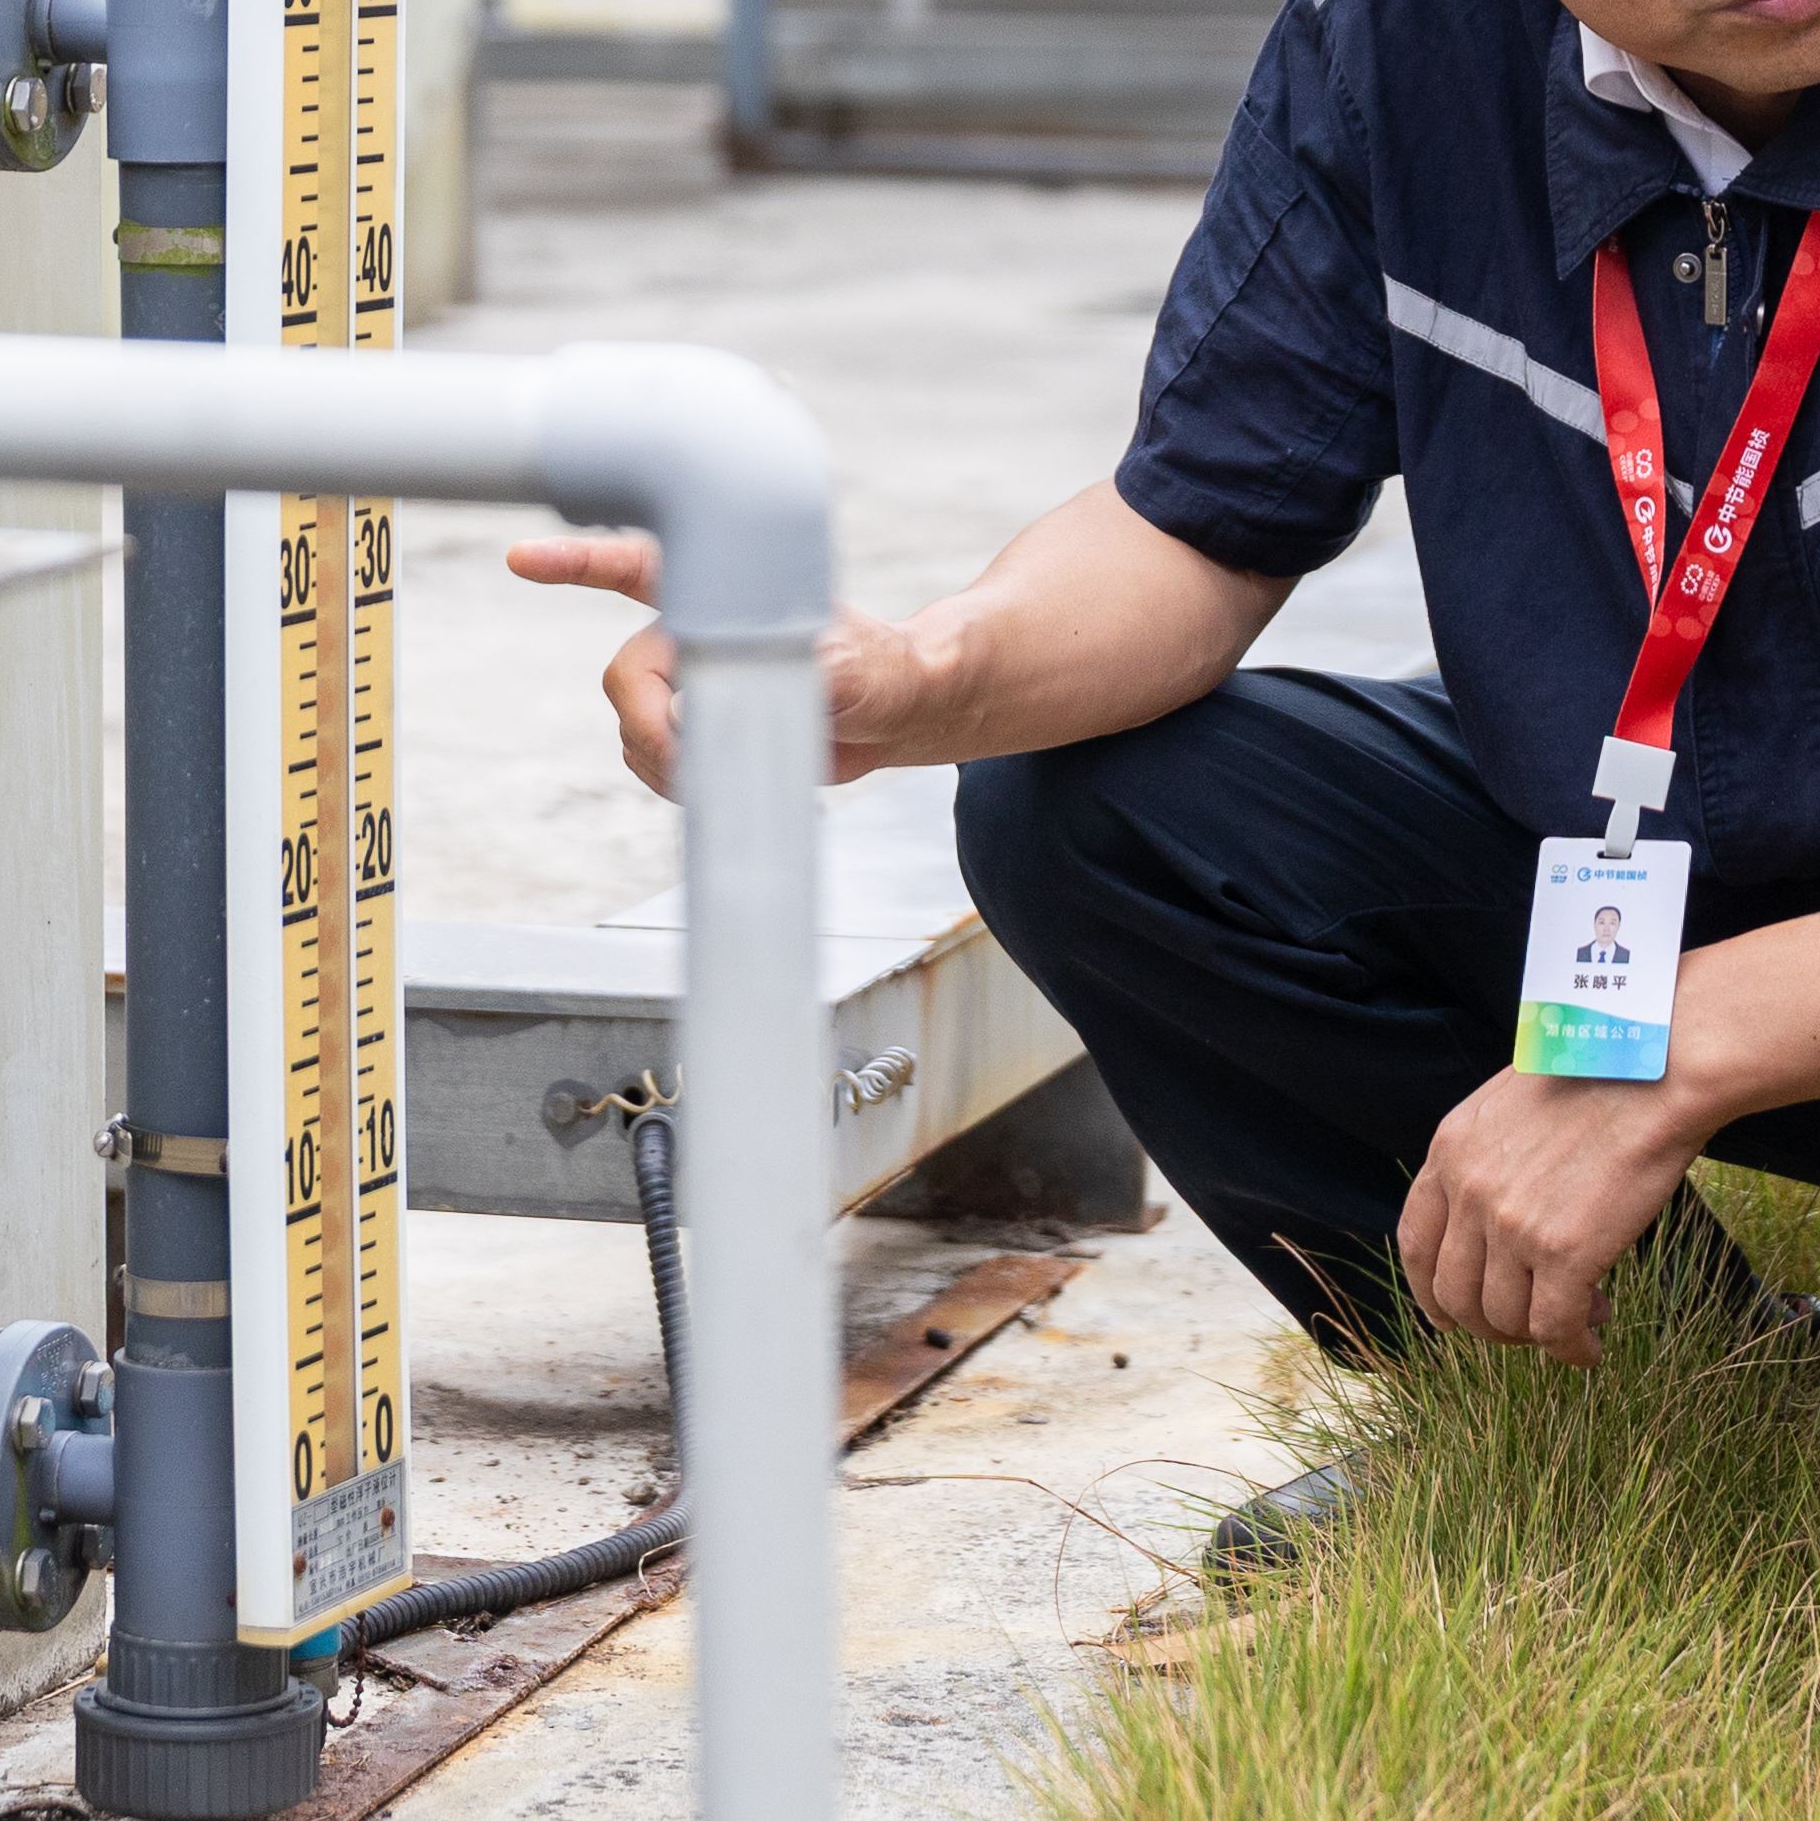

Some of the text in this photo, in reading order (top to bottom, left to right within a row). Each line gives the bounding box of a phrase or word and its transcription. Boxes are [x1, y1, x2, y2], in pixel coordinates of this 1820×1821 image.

[281, 236, 311, 307] 40
[361, 223, 392, 293] 40
[1717, 428, 1771, 524] 中节能国祯
[280, 535, 310, 610] 30
[360, 515, 391, 589] 30
[281, 833, 311, 908] 20
[361, 808, 392, 881] 20
[1573, 973, 1628, 991] 张晓平
[285, 1130, 314, 1205] 10
[366, 1099, 395, 1173] 10
[375, 1394, 393, 1464] 0
[294, 1431, 312, 1502] 0
